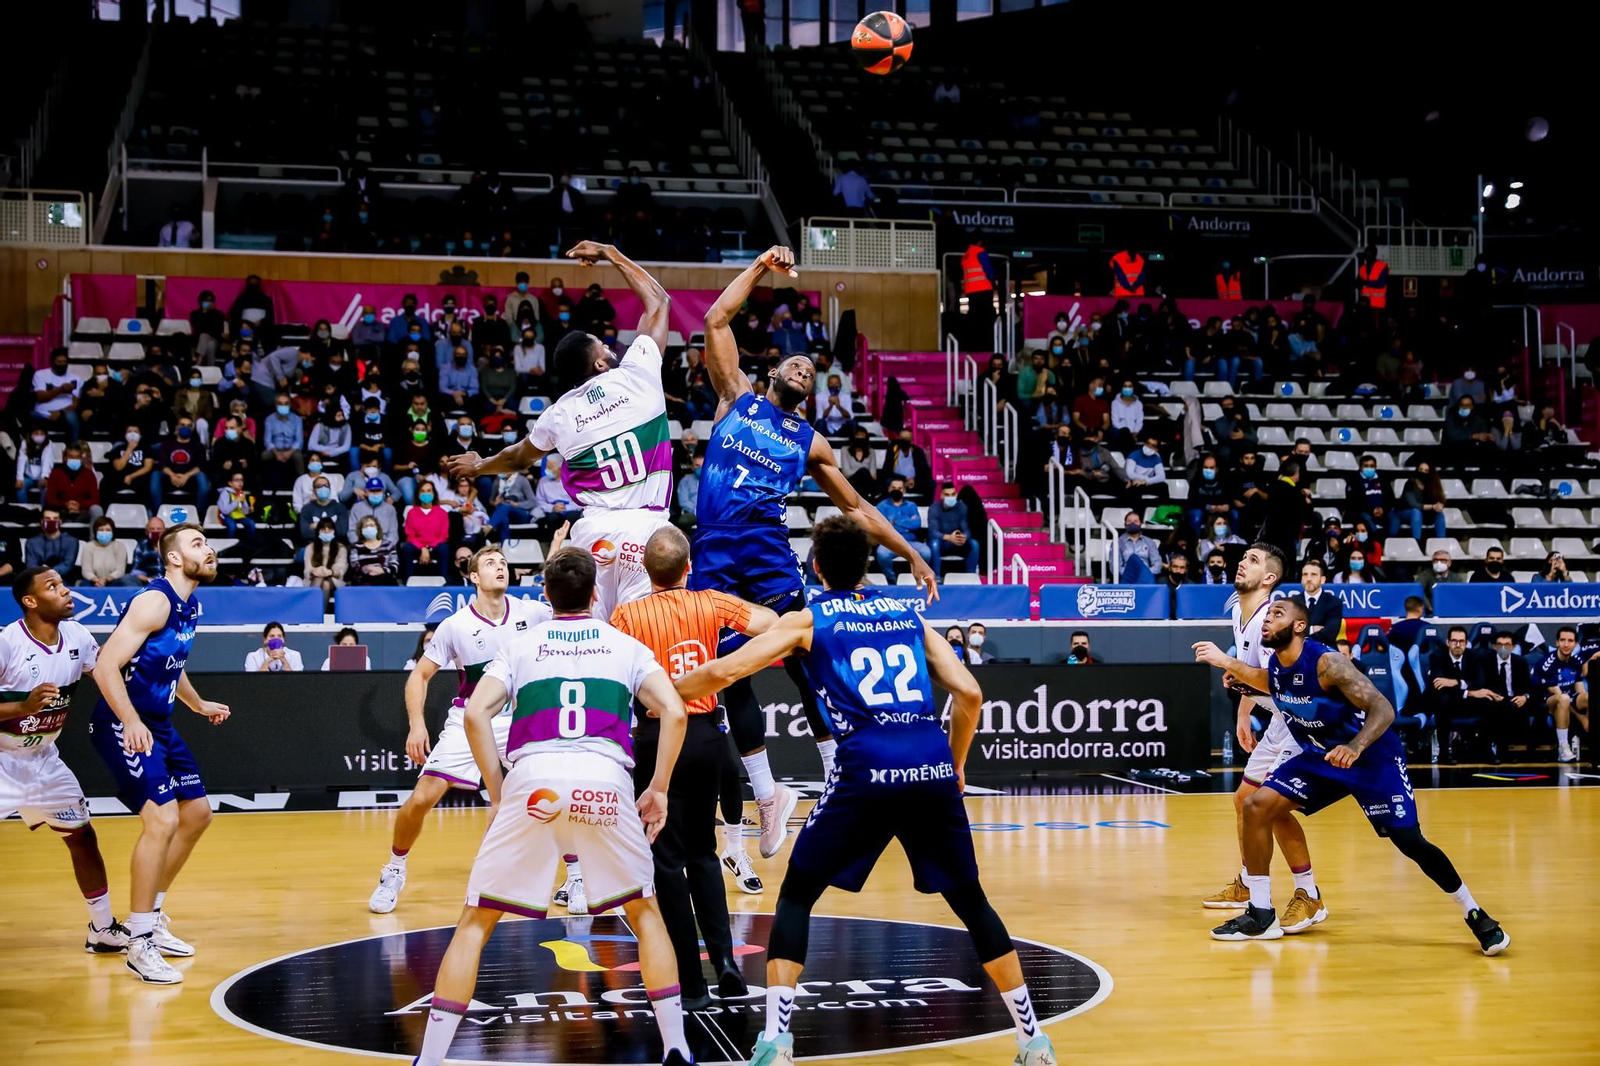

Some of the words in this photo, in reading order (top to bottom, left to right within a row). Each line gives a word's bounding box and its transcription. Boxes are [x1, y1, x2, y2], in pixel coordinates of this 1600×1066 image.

[1188, 215, 1250, 232] Andorra
[1512, 266, 1586, 283] Andorra
[587, 385, 606, 405] ERIC
[742, 415, 797, 451] MORABANC
[592, 431, 647, 489] 50
[732, 440, 782, 474] Andorra
[733, 464, 750, 489] 7
[1003, 531, 1032, 539] telecom
[621, 541, 645, 554] COS
[620, 552, 638, 563] DEL
[1526, 588, 1600, 609] Andorr
[547, 628, 600, 643] BRIZUELA
[846, 620, 917, 633] MORABANC
[670, 651, 699, 680] 35
[850, 644, 924, 706] 22
[559, 680, 586, 738] 8
[981, 737, 1167, 760] visitandorra.com
[571, 789, 619, 805] COSTA
[569, 803, 595, 815] DEL
[598, 806, 619, 816] SOL
[568, 815, 619, 827] MÁLAGA
